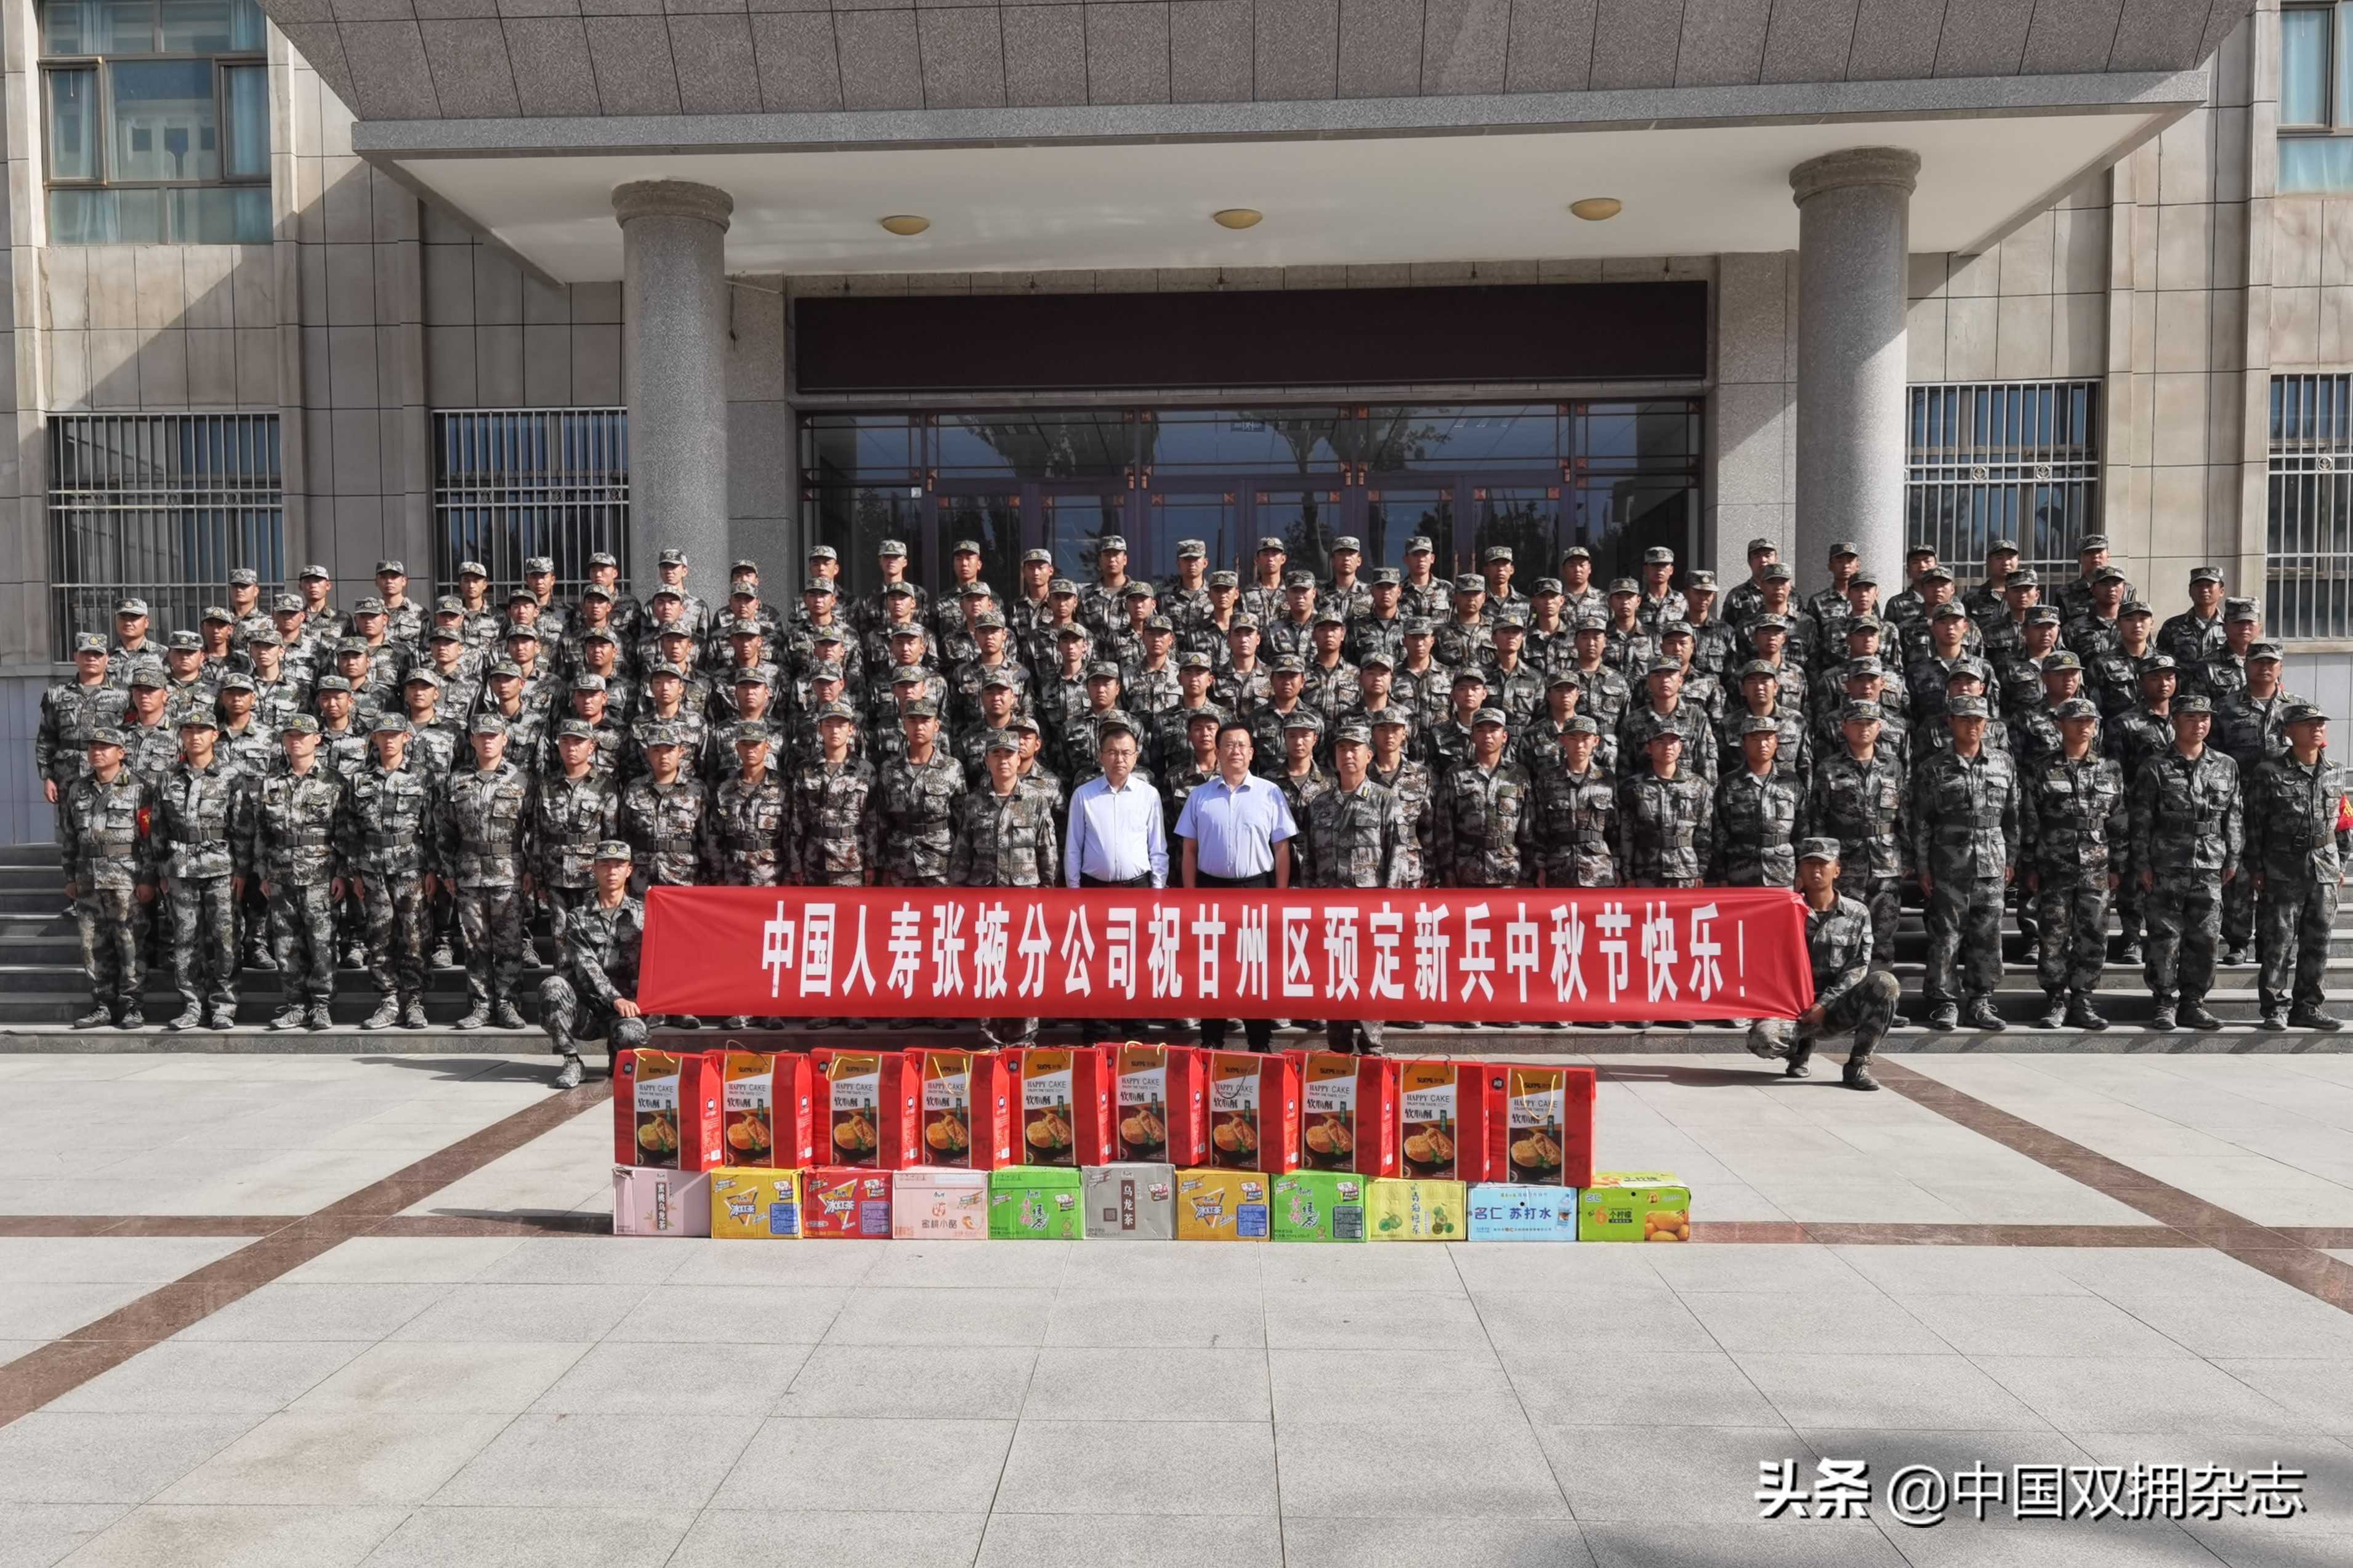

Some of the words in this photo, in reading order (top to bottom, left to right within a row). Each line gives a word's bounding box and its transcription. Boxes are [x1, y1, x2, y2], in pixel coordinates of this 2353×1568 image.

[762, 900, 1745, 1003] 中国人寿张掖分公司祝甘州区预定新兵中秋节快乐！
[1048, 1080, 1067, 1088] CAKE
[1142, 1077, 1160, 1086] CAKE
[639, 1084, 655, 1092] HAPPY
[658, 1085, 674, 1093] CAKE
[729, 1083, 746, 1091] HAPPY
[749, 1084, 767, 1092] CAKE
[836, 1082, 853, 1090] HAPPY
[856, 1083, 873, 1092] CAKE
[1309, 1084, 1328, 1093] HAPPY
[1331, 1085, 1350, 1095] CAKE
[1430, 1094, 1450, 1103] CAKE
[1123, 1185, 1134, 1226] 乌龙茶
[1474, 1207, 1503, 1220] 名仁
[1509, 1207, 1552, 1220] 苏打水
